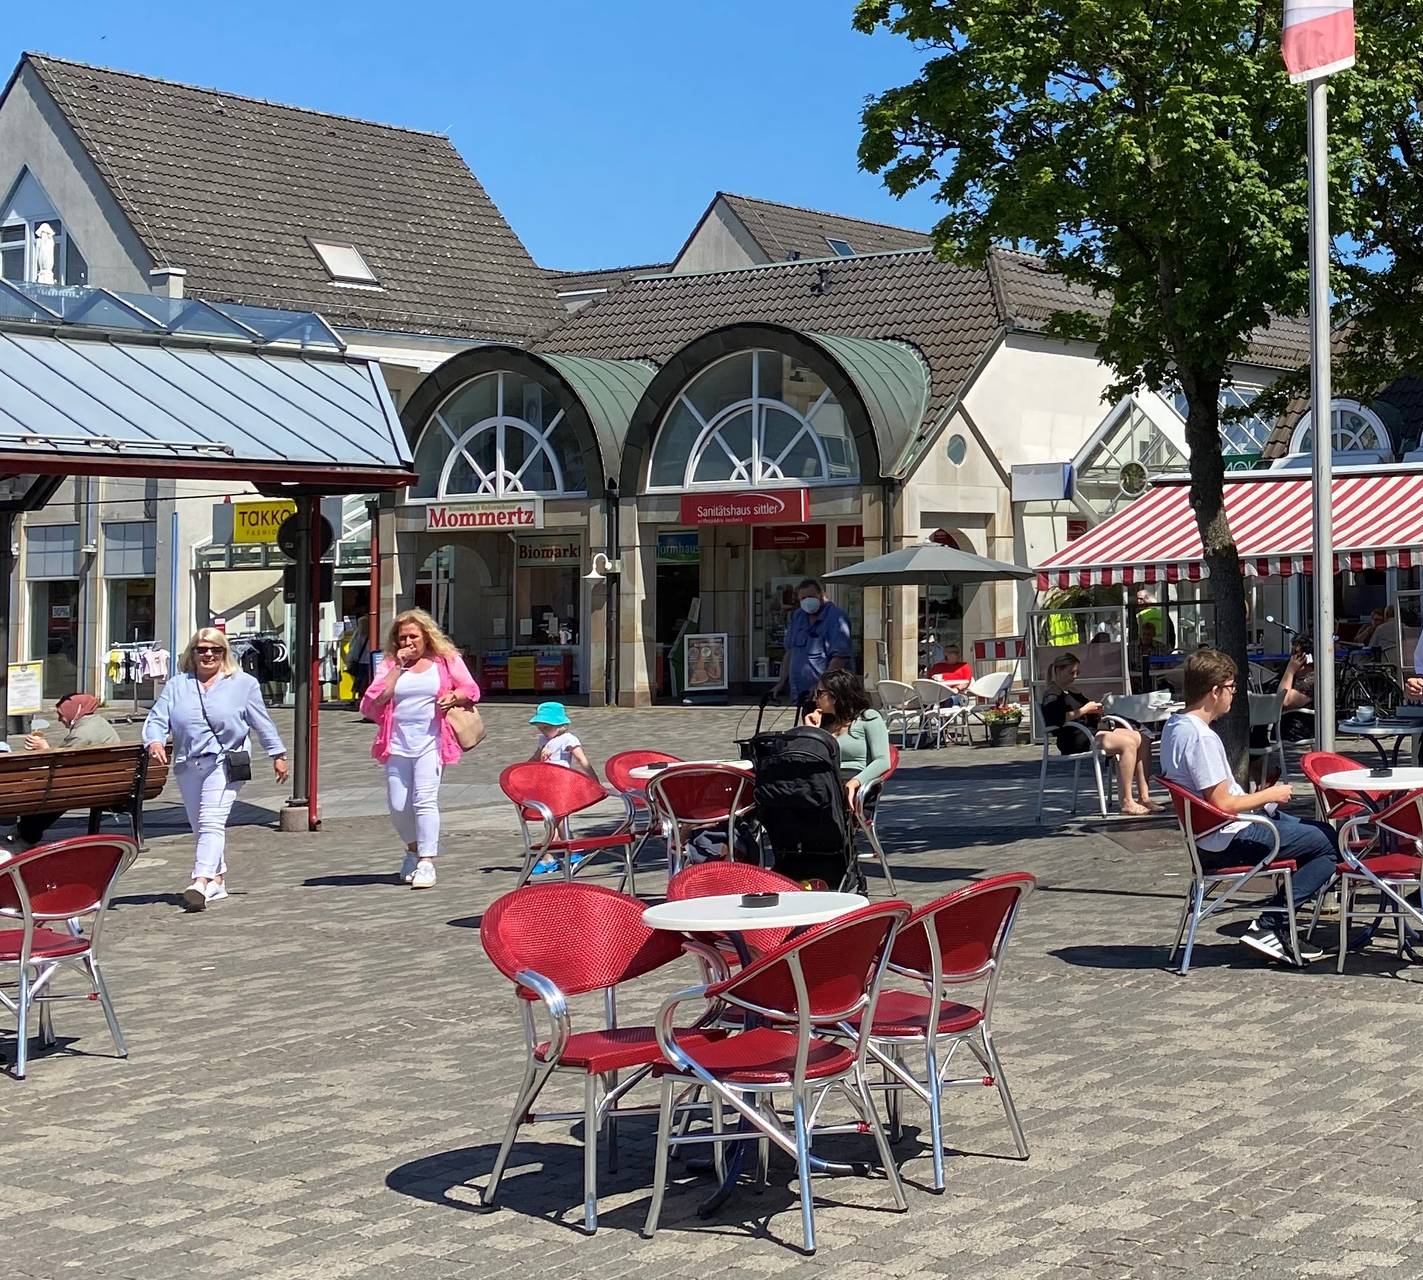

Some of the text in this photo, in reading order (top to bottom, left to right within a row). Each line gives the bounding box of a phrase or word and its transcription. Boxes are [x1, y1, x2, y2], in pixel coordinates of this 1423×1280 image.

[428, 506, 534, 528] Mommertz
[697, 503, 778, 518] Sanitätshaus sittler
[246, 528, 278, 536] FASHIO
